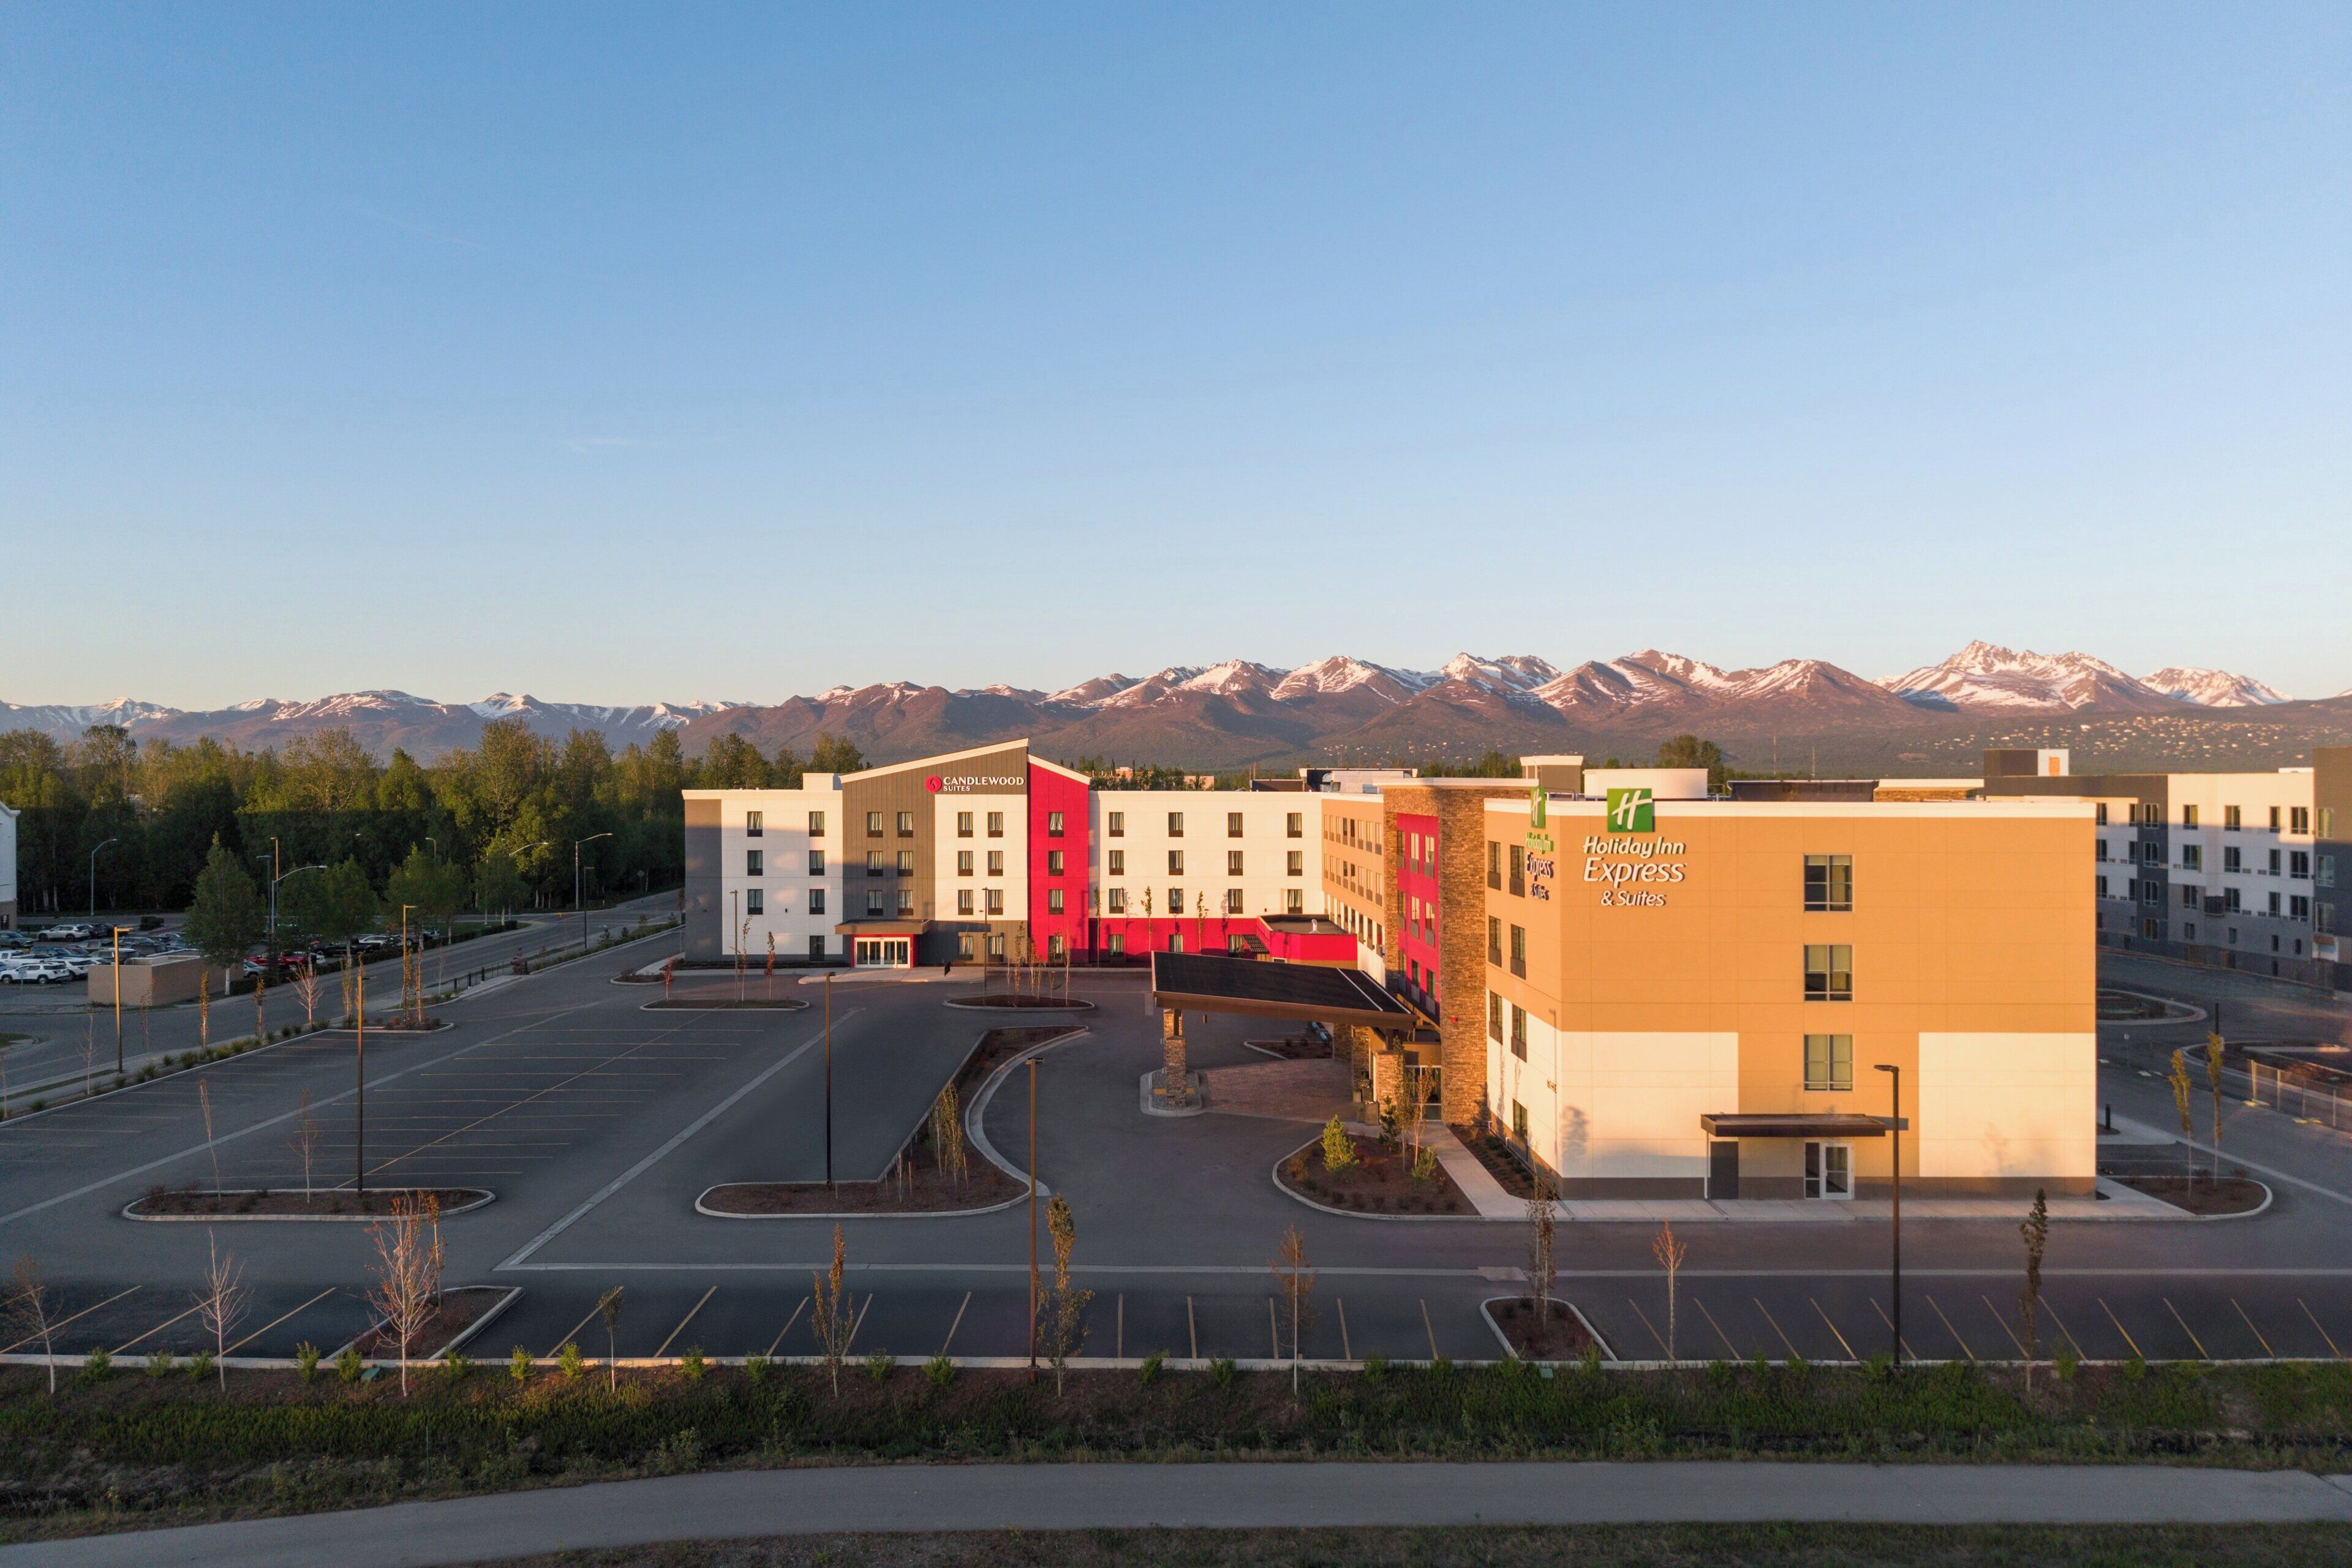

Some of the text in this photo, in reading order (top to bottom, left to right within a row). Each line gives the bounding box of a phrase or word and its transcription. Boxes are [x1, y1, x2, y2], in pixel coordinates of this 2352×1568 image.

[943, 776, 1025, 785] CANDLEWOOD
[1611, 790, 1653, 831] H
[1526, 832, 1553, 854] Holiday Inn
[1583, 835, 1686, 859] Holiday Inn
[1526, 851, 1553, 881] Express
[1583, 857, 1686, 889] Express
[1533, 883, 1549, 900] Suites
[1600, 890, 1666, 907] & Suites
